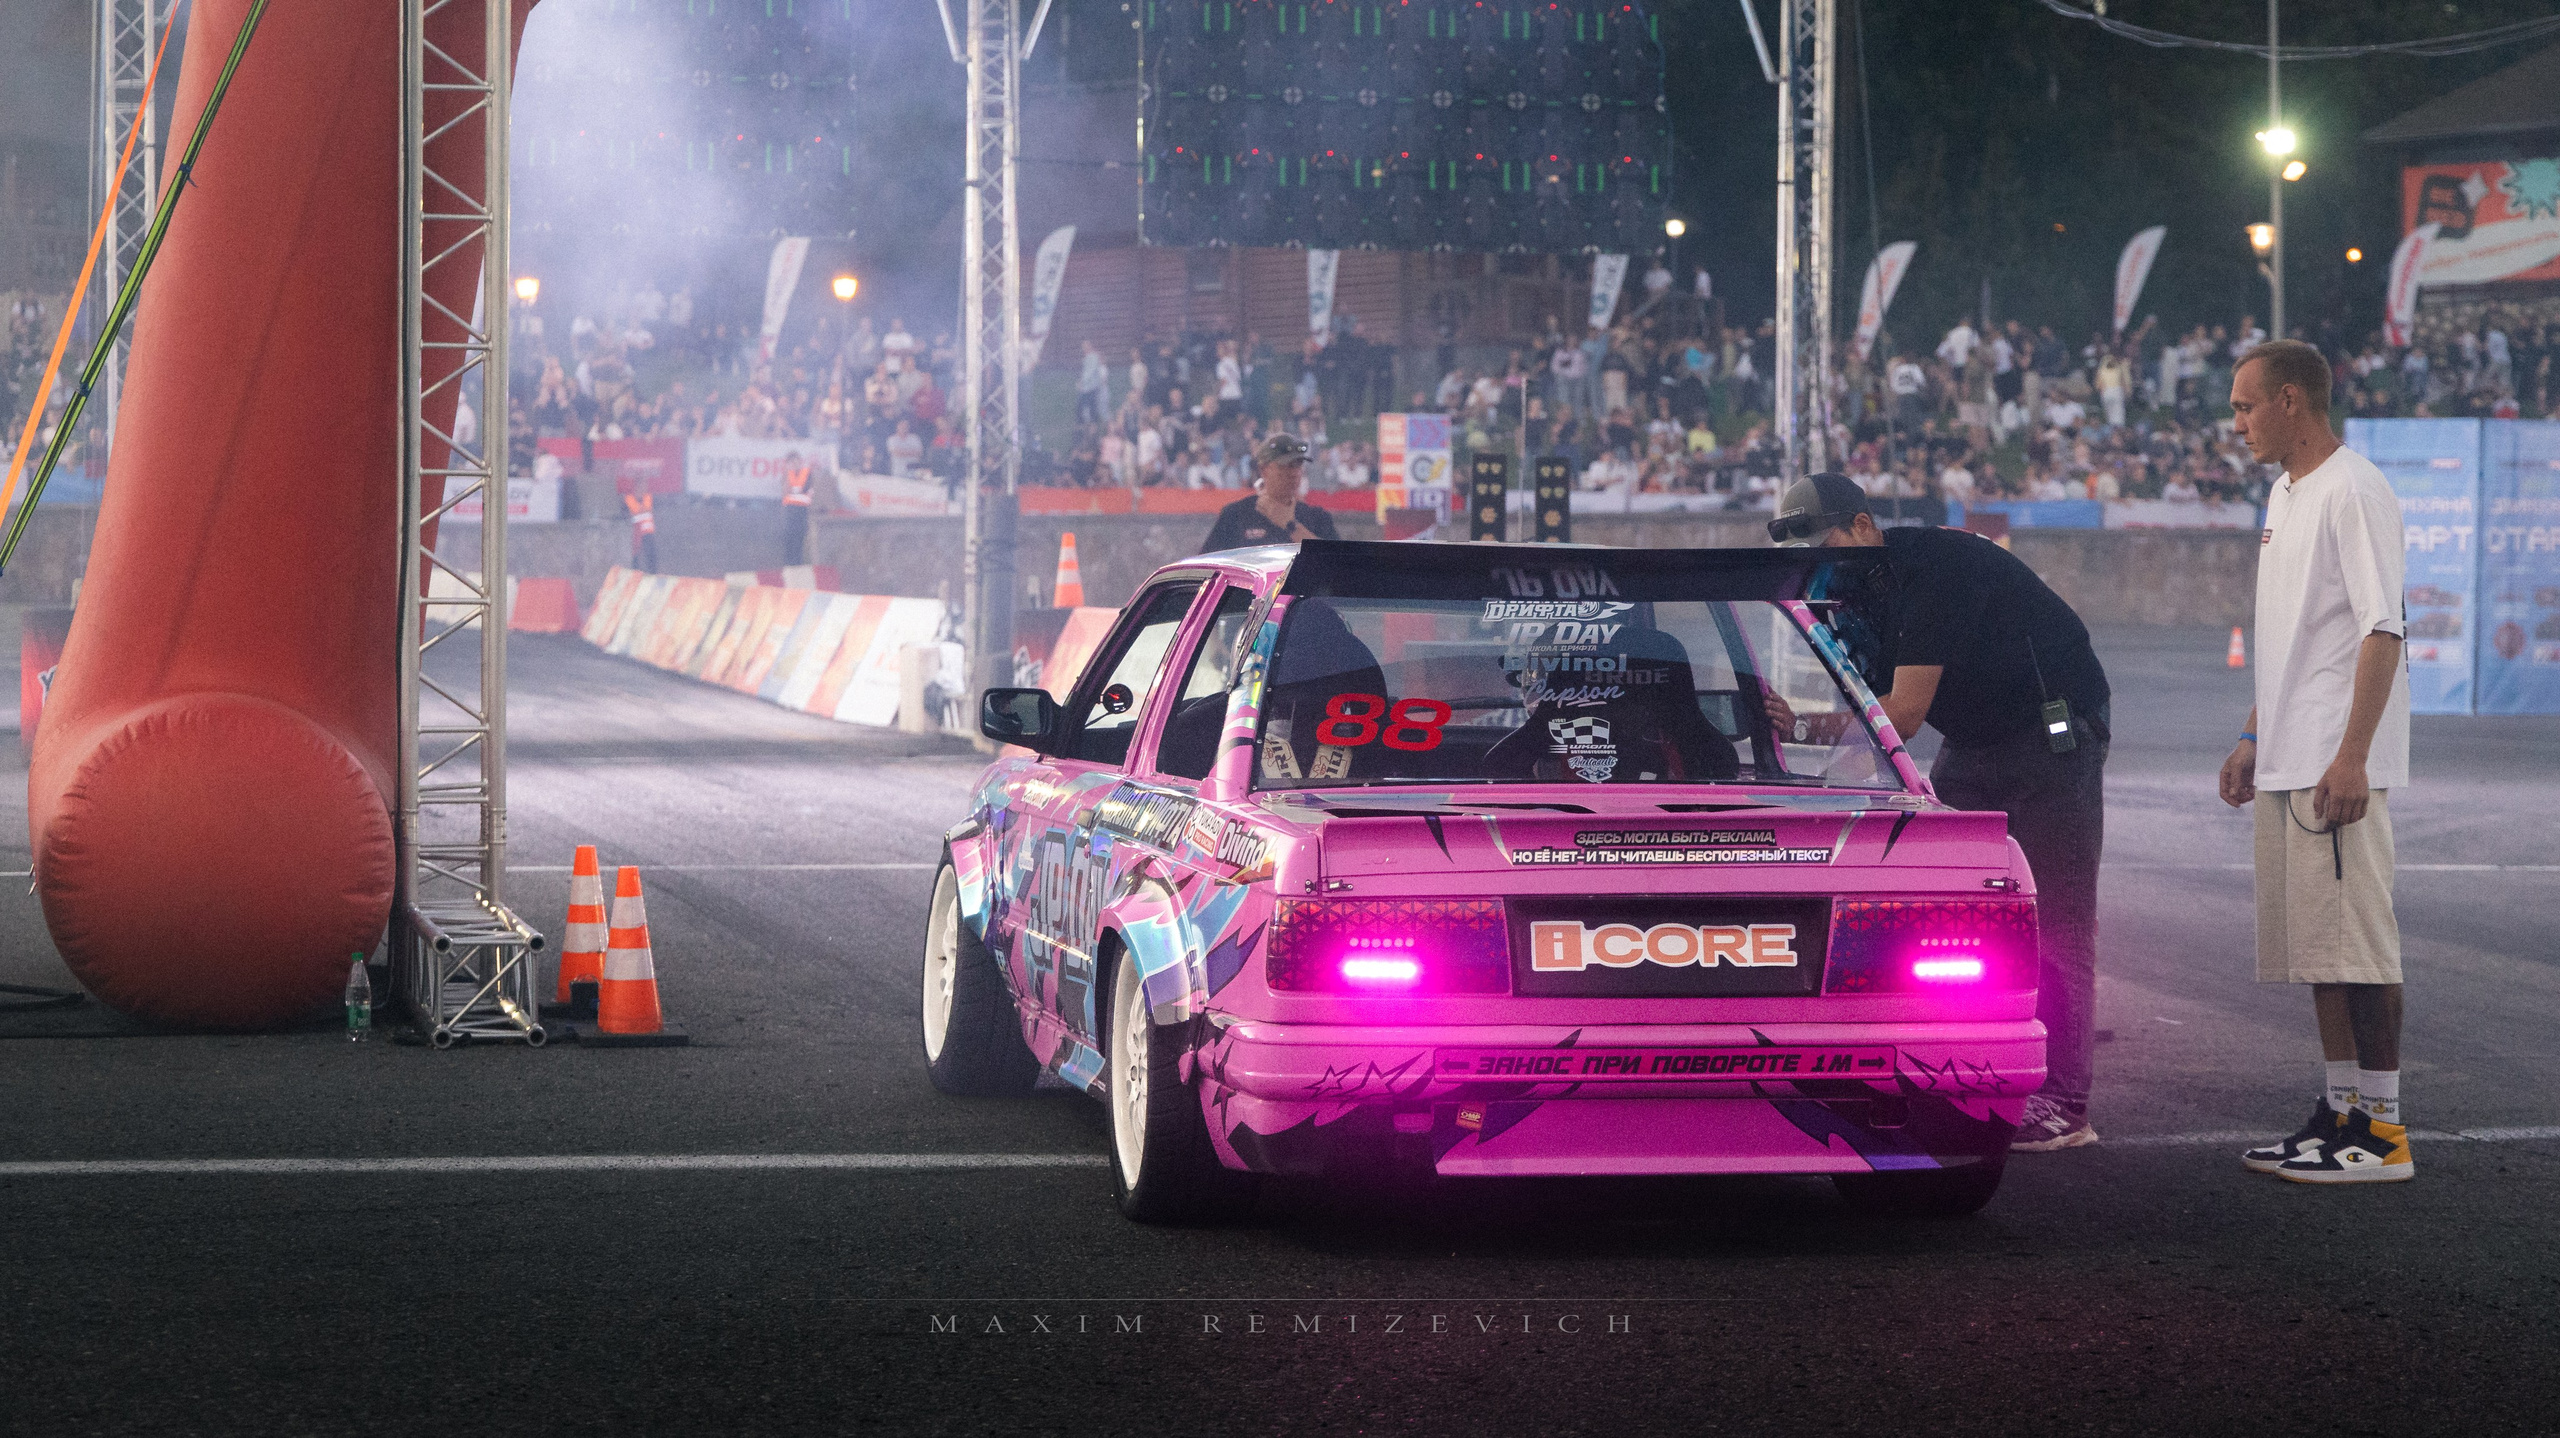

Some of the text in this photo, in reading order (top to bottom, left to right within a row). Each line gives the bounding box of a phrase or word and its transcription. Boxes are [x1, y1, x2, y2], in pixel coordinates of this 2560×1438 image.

[1494, 622, 1544, 645] JP
[1503, 652, 1628, 671] Divinol
[1523, 679, 1625, 708] Capson
[1316, 693, 1452, 751] 88
[1217, 820, 1279, 873] Divinol
[1576, 830, 1776, 844] ЗДЕСЬ МОГЛА БЫТЬ РЕКЛАМА,
[1512, 851, 1532, 863] НО
[1534, 847, 1550, 862] ЕЁ
[1586, 850, 1598, 862] И
[1599, 850, 1620, 862] ТЫ
[1621, 850, 1685, 862] ЧИТАЕШЬ
[1686, 847, 1787, 862] БЕСПОЛЕЗНЫЙ
[1788, 849, 1829, 861] ТЕКСТ
[1476, 1056, 1573, 1075] ЗАНОС
[1581, 1055, 1641, 1074] ПРИ
[1650, 1055, 1801, 1074] ПОВОРОТЕ
